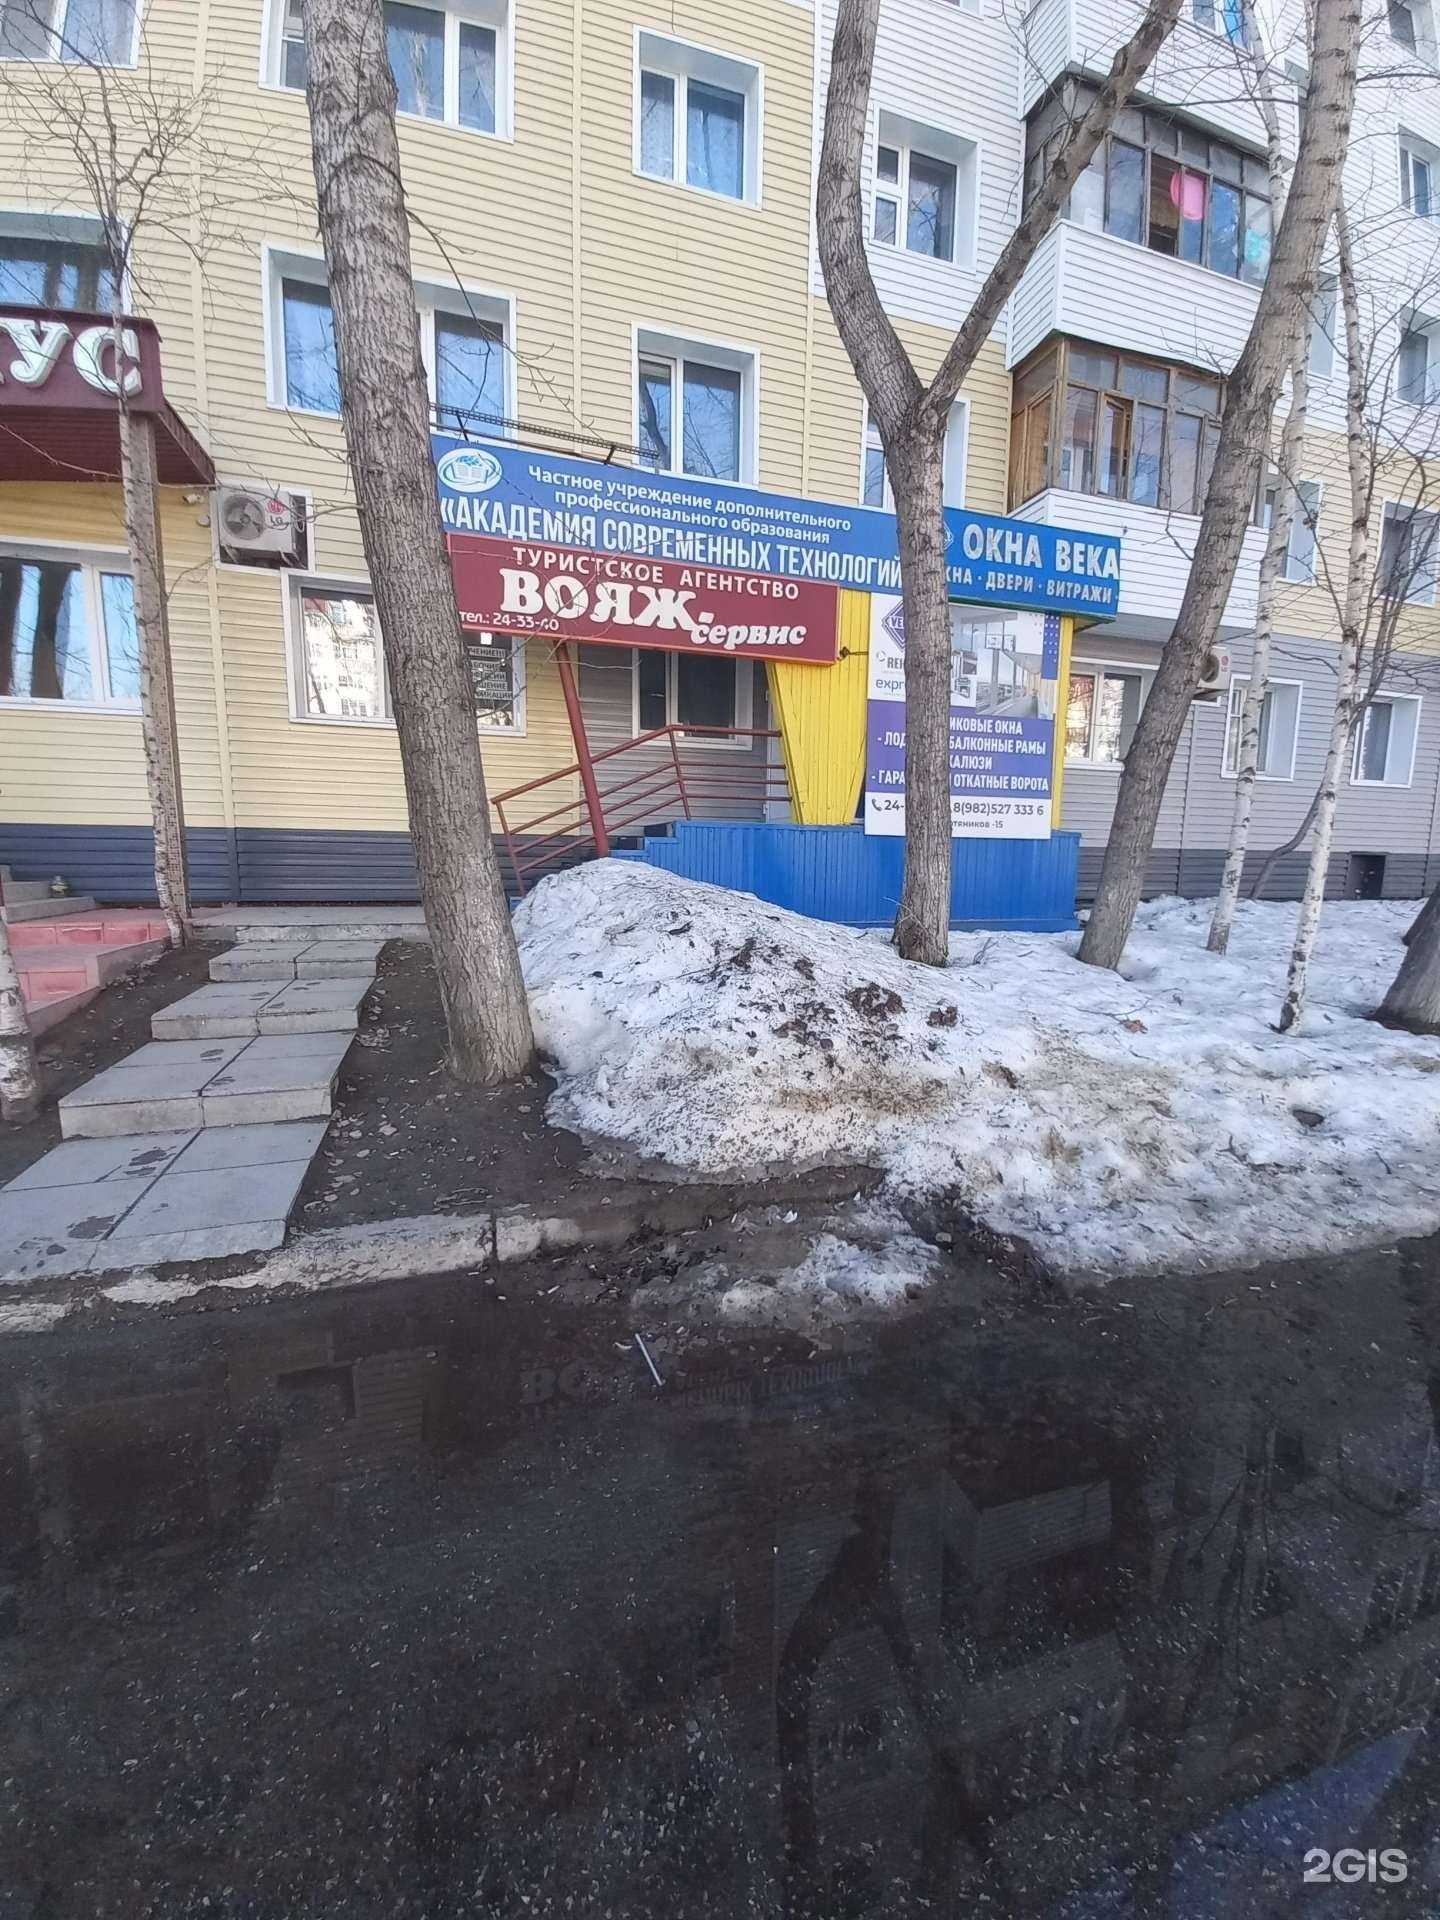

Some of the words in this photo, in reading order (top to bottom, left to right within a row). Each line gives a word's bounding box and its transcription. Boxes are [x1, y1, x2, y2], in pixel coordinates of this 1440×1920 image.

[0, 317, 143, 397] УС
[529, 465, 602, 491] Частное
[606, 481, 712, 510] учреждение
[715, 500, 851, 531] дополнительного
[555, 491, 728, 528] профессионального
[732, 518, 830, 545] образования
[603, 518, 771, 573] СОВРЕМЕННЫХ
[963, 523, 1043, 568] ОКНА
[1055, 539, 1120, 580] ВЕКА
[512, 547, 664, 584] ТУРИСТСКОЕ
[680, 569, 799, 600] АГЕНТСТВО
[985, 571, 1034, 593] ДВЕРИ
[1046, 579, 1112, 604] ВИТРАЖИ
[691, 624, 808, 651] сервис
[875, 679, 905, 692] expr
[949, 716, 993, 733] ИКОВЫЕ
[995, 719, 1023, 735] ОКНА
[884, 731, 906, 749] ЛОД
[949, 735, 1013, 753] БАЛКОННЫЕ
[1015, 740, 1046, 755] РАМЫ
[878, 769, 906, 785] ГАРА
[953, 773, 1008, 790] ОТКАТНЫЕ
[1010, 777, 1049, 792] ВОРОТА
[953, 802, 1011, 816] 8(982)527
[1014, 804, 1034, 816] 333
[1037, 804, 1044, 816] 6
